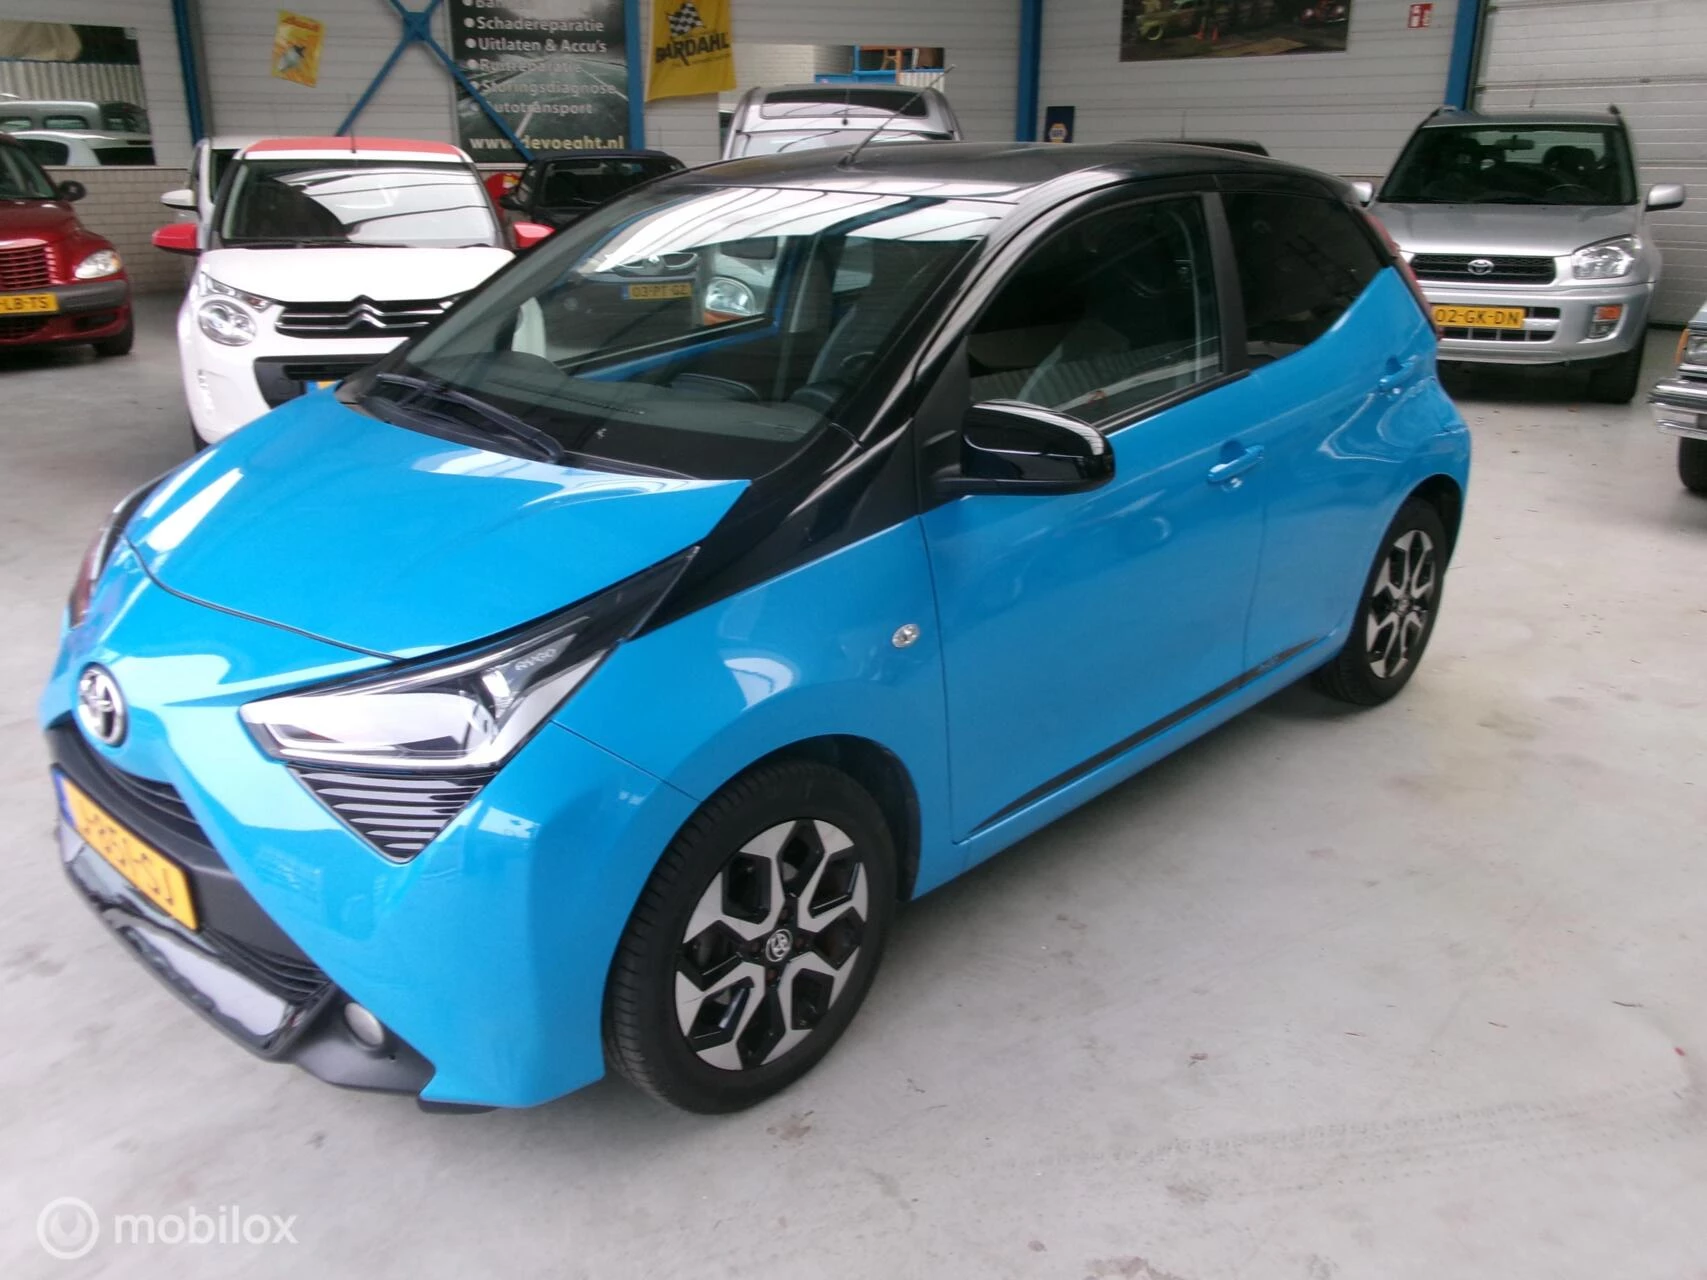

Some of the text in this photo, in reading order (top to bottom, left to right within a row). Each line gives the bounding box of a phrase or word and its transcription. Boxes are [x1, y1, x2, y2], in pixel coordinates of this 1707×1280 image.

[476, 16, 605, 33] Schadereparatie
[478, 37, 607, 53] Uitlaten & Accu's
[490, 101, 593, 117] utotransport
[1434, 308, 1521, 325] 02-GK-DN
